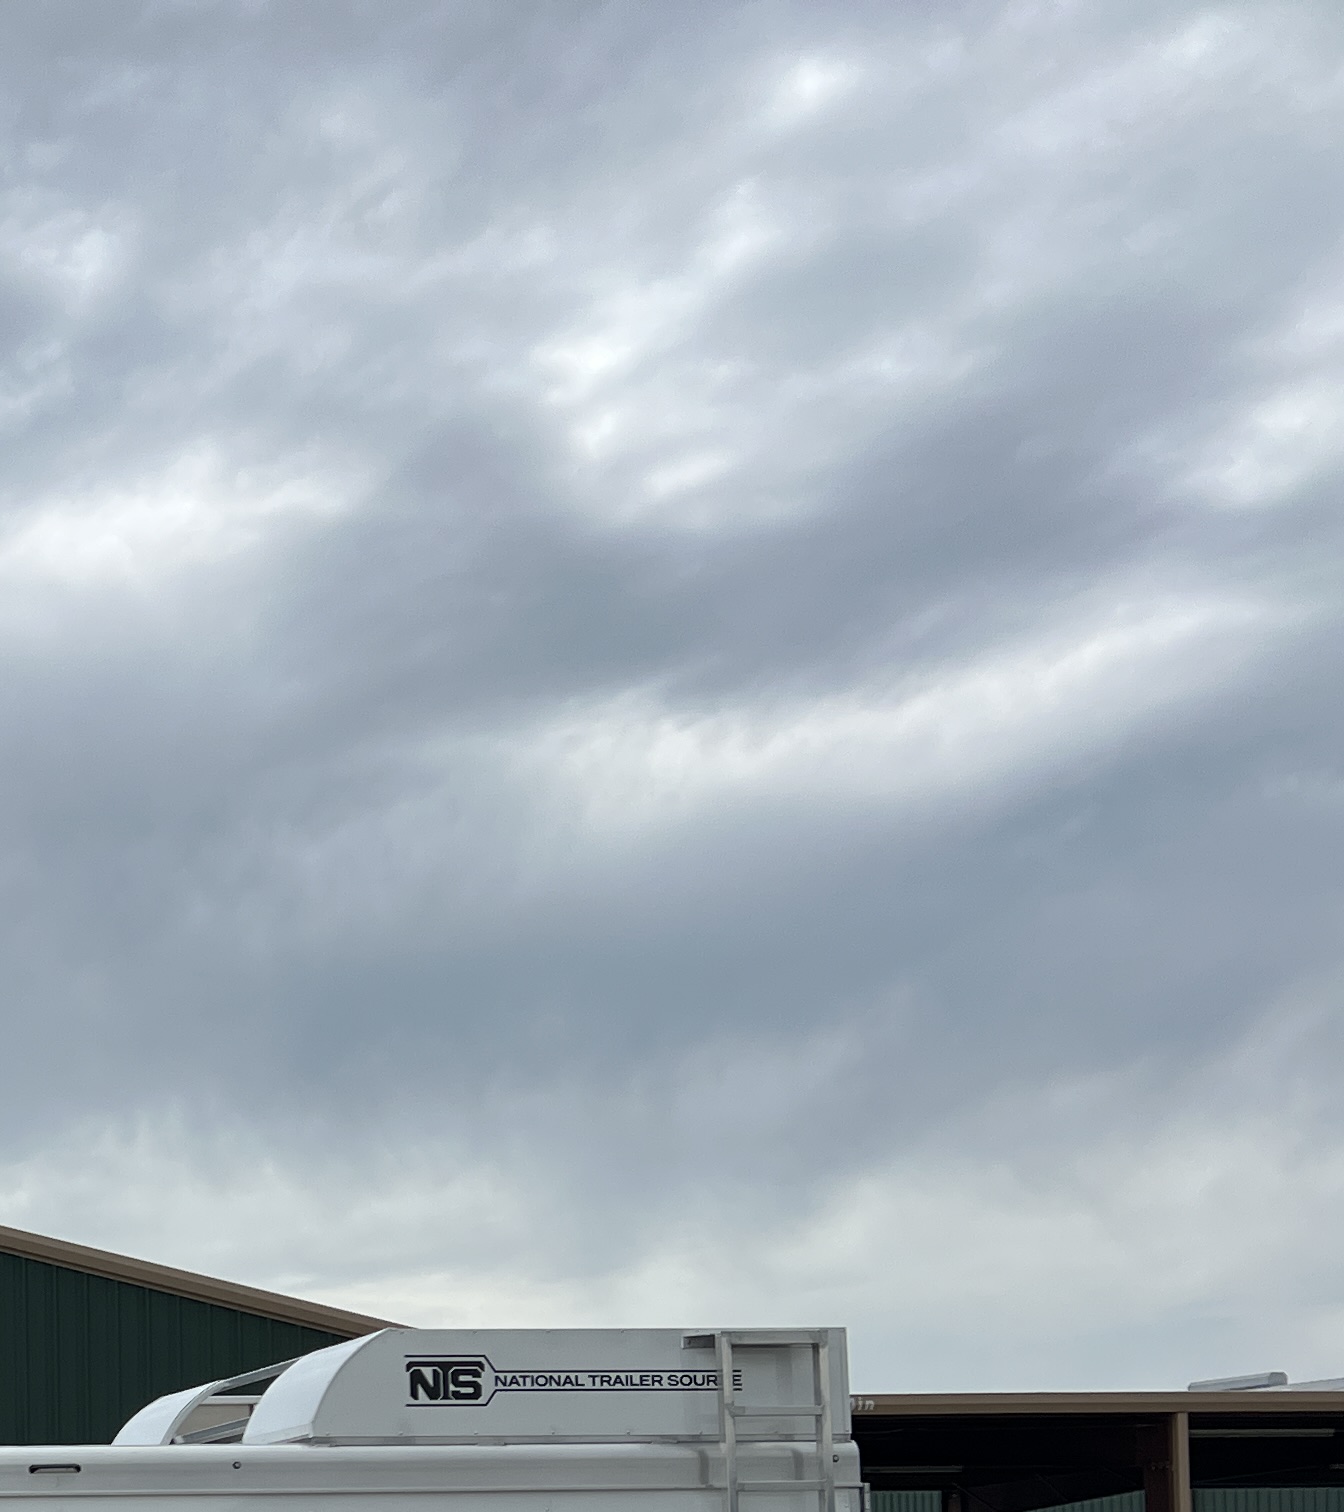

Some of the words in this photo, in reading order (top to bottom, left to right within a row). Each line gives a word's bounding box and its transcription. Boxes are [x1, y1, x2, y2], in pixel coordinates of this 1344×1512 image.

[405, 1360, 485, 1401] NTS
[494, 1374, 585, 1388] NATIONAL
[588, 1373, 664, 1387] TRAILER
[667, 1373, 743, 1387] SOURE
